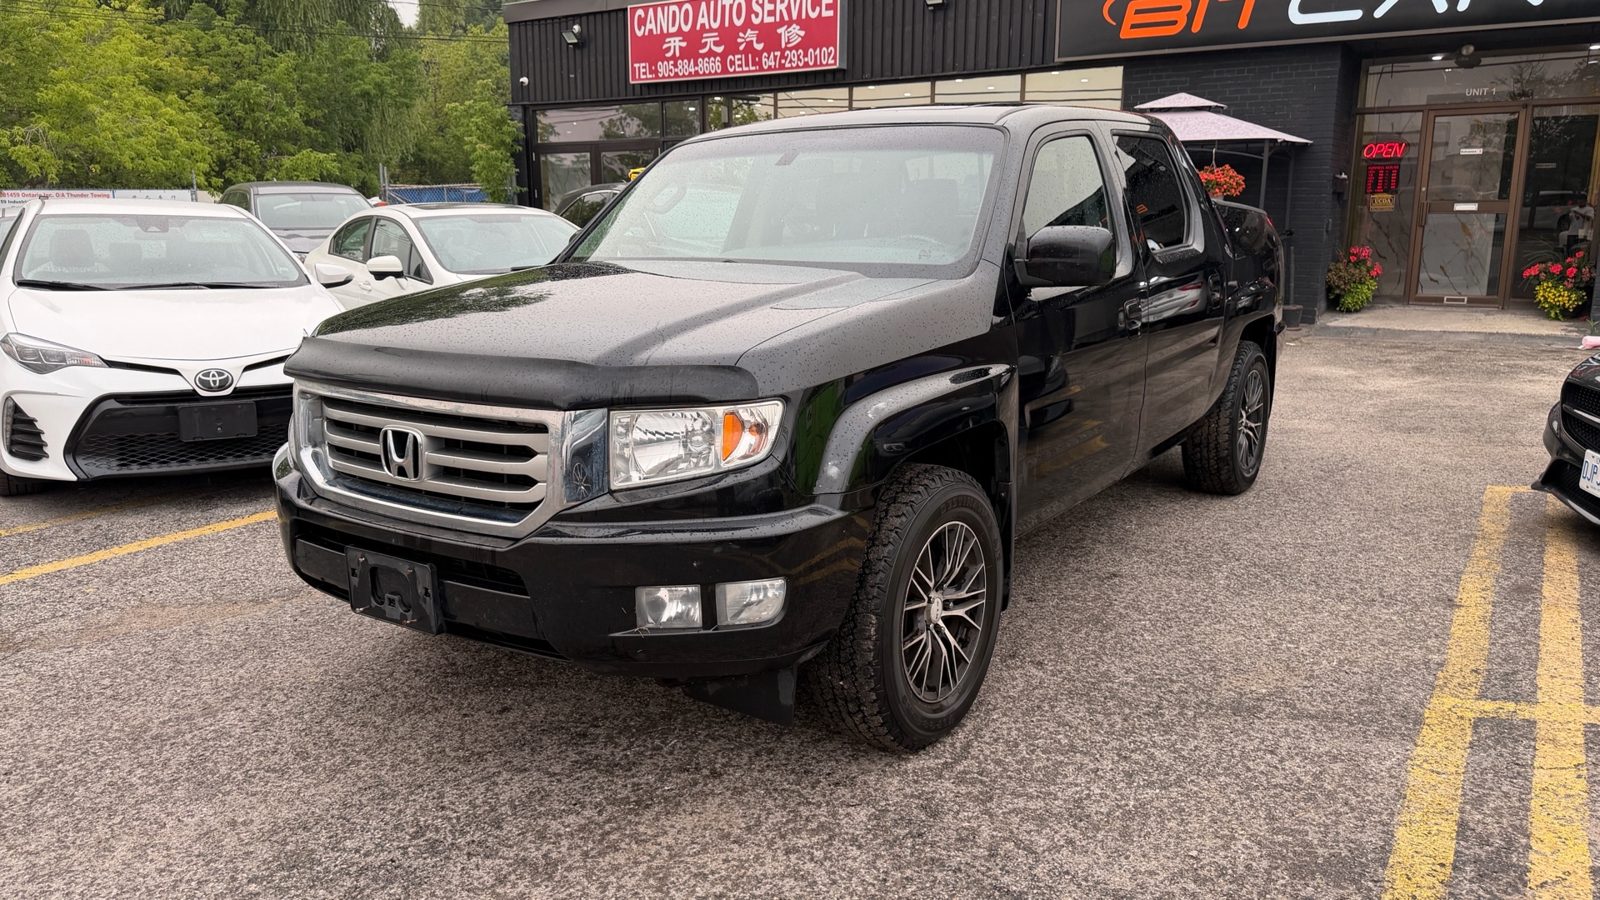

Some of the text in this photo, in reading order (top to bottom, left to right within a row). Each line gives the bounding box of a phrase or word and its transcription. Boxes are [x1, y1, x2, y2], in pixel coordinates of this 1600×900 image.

[634, 0, 834, 37] CANDO AUTO SERVICE
[663, 24, 805, 57] 开元汽修
[634, 47, 835, 79] TEL: 905-884-8666 CELL: 647-293-0102
[1465, 88, 1489, 96] UNIT
[1363, 142, 1406, 158] OPEN
